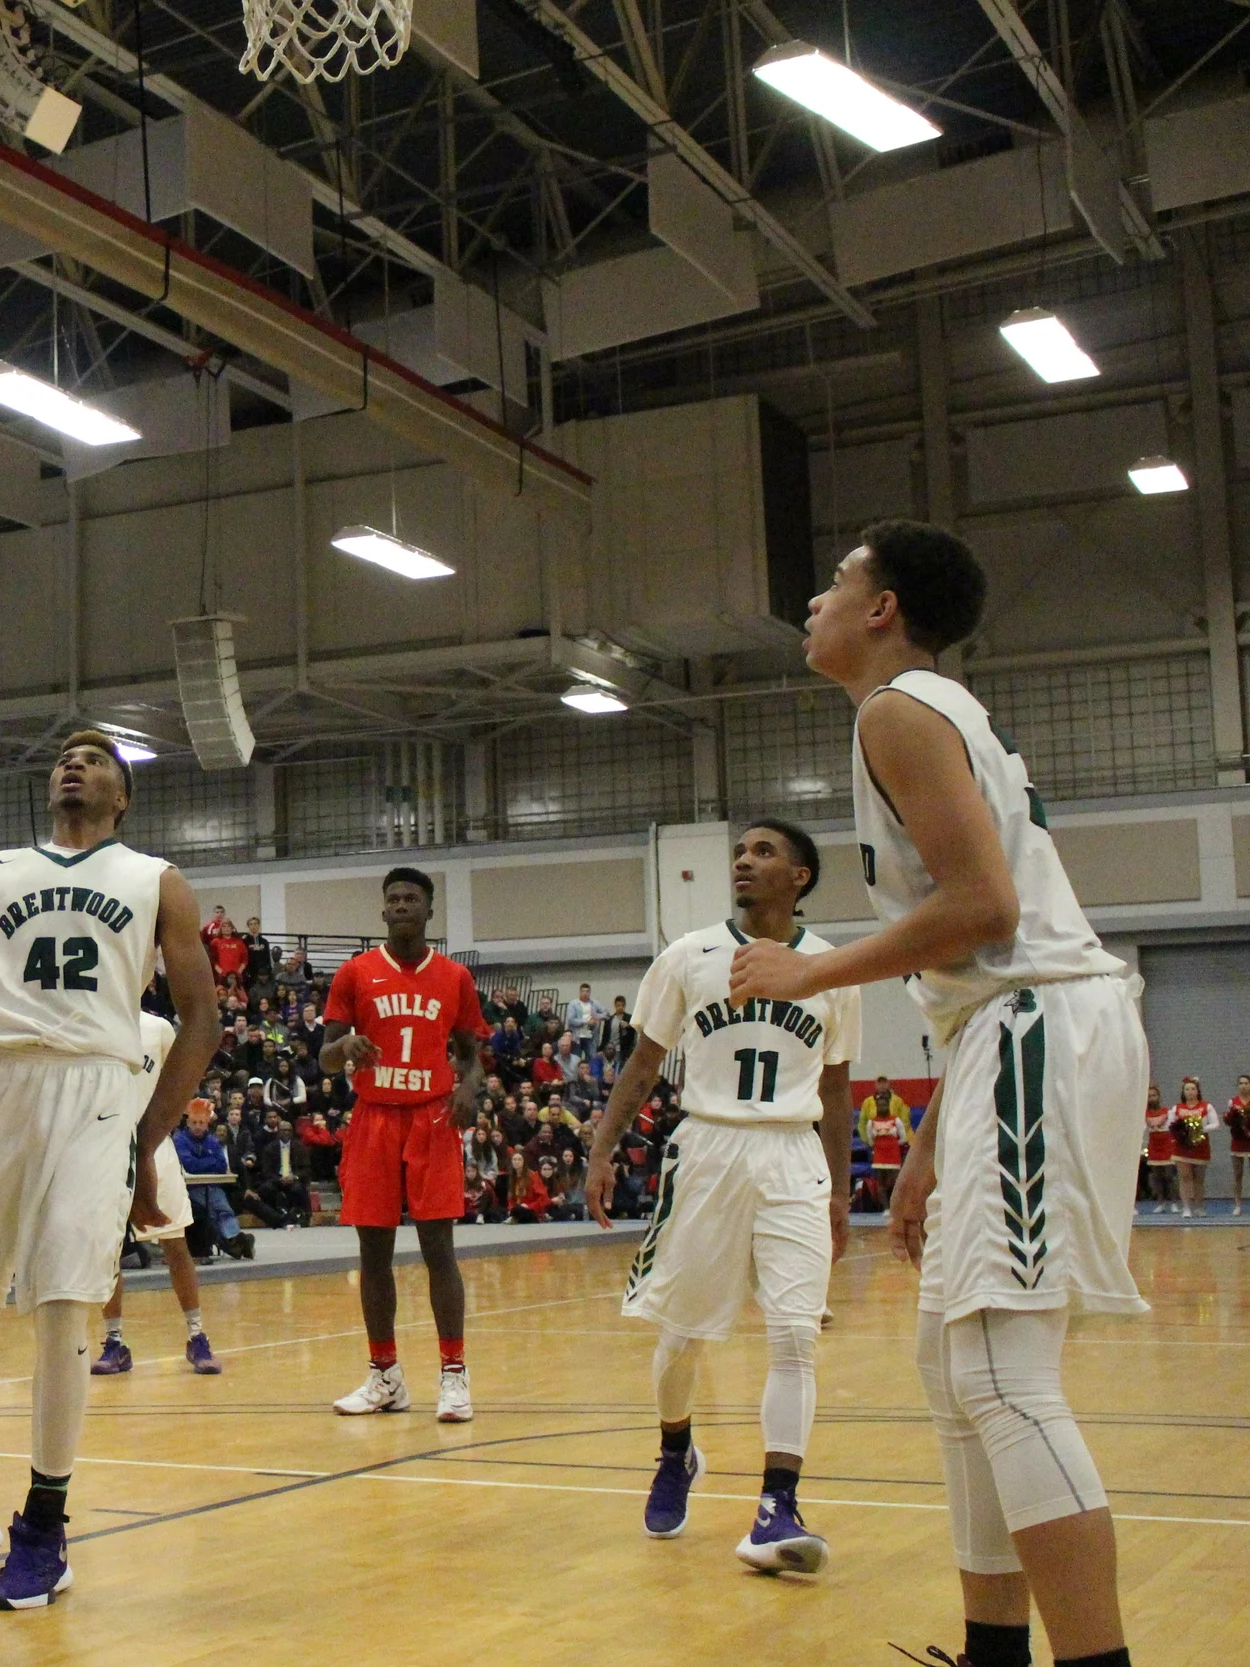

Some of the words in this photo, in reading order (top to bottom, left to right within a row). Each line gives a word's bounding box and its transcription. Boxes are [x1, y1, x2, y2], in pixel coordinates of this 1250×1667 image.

[23, 936, 99, 992] 42
[372, 993, 441, 1021] HILLS
[400, 1026, 414, 1063] 1
[374, 1066, 432, 1092] WEST
[734, 1048, 779, 1102] 11
